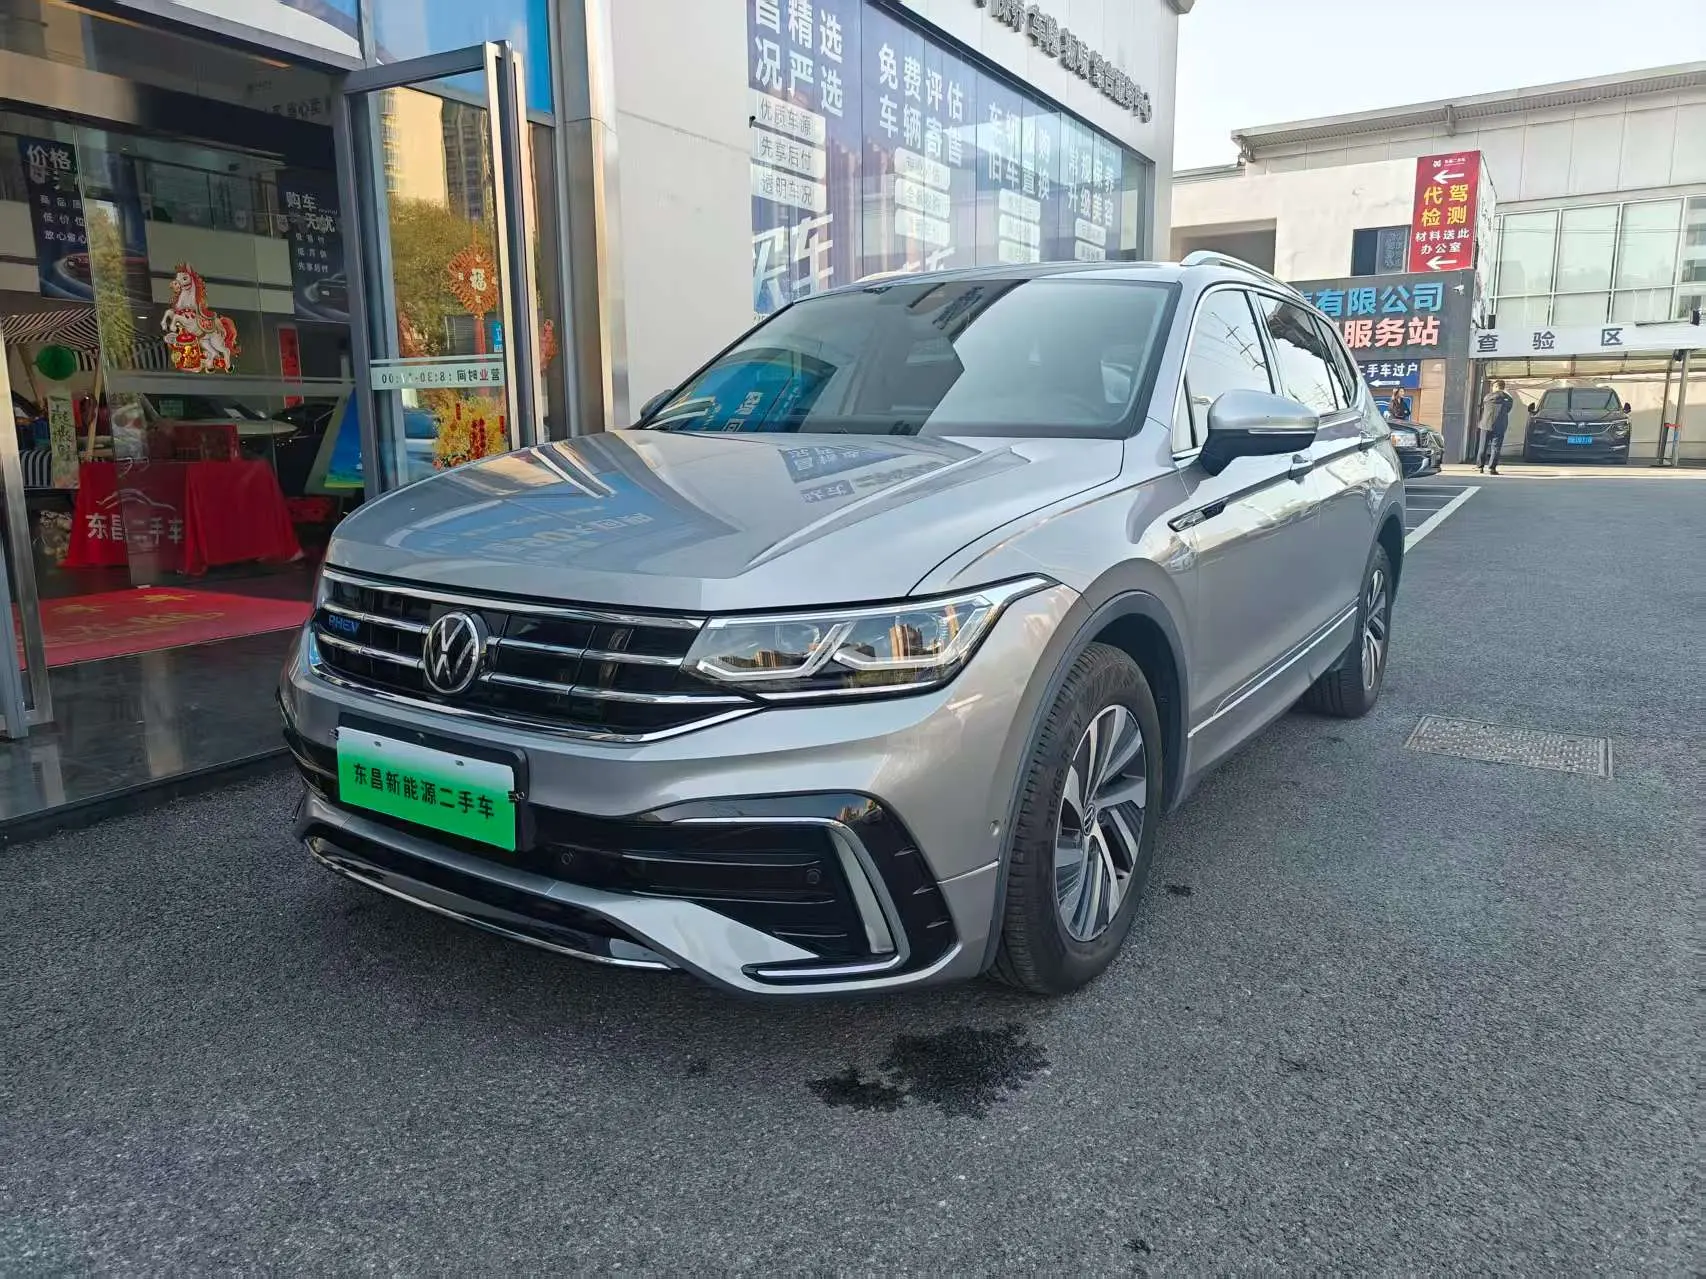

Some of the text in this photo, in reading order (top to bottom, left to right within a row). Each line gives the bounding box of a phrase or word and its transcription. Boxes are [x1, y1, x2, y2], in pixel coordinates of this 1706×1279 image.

[754, 35, 844, 118] 况严选
[879, 42, 964, 122] 免费评估
[760, 97, 812, 136] 优质车源
[879, 94, 964, 168] 车辆寄售
[26, 144, 72, 170] 价格
[760, 135, 812, 171] 先享后付
[286, 191, 318, 212] 购车
[761, 172, 813, 207] 透明车况
[1423, 183, 1469, 206] 代驾
[1421, 205, 1468, 227] 检测
[1415, 228, 1470, 243] 材料送此
[1420, 242, 1462, 256] 办公室
[1300, 281, 1444, 317] 有限公司
[1335, 315, 1441, 349] 服务站
[1477, 327, 1624, 353] 查验区
[85, 512, 183, 545] 东昌二手车
[353, 762, 495, 820] 东昌新能源二手车
